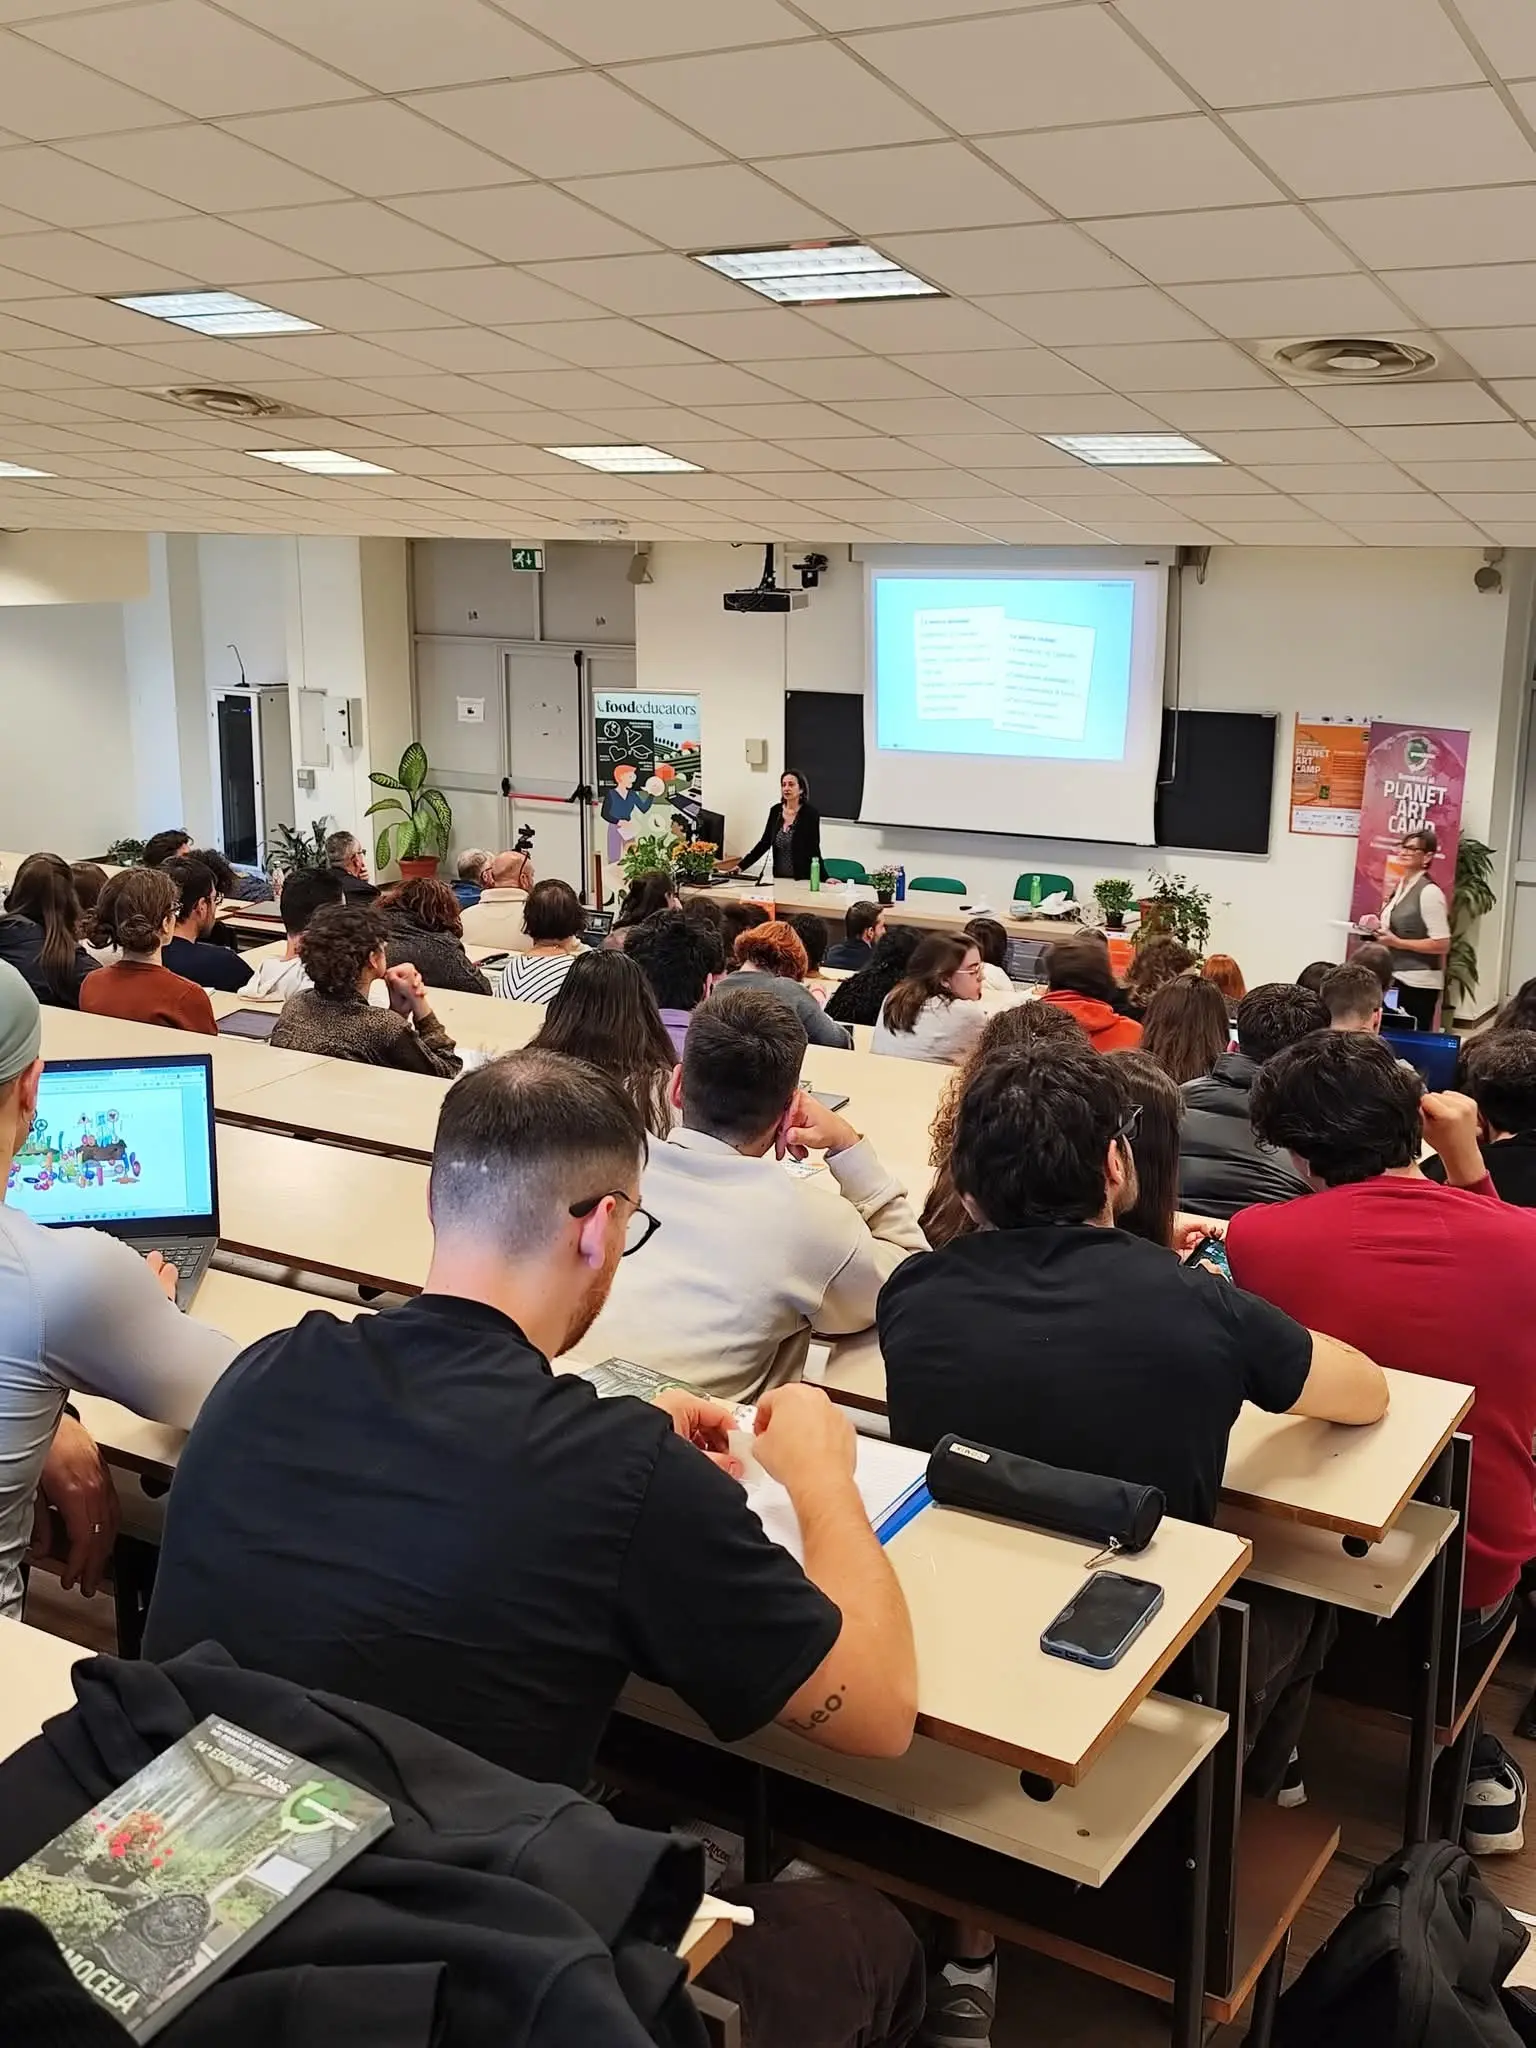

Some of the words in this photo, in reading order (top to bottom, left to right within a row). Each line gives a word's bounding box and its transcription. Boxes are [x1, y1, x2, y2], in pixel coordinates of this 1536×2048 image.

[605, 700, 697, 715] foodeducators
[1296, 748, 1331, 758] PLANET
[1295, 765, 1321, 774] CAMP
[1383, 780, 1448, 805] PLANET
[1396, 799, 1430, 819] ART
